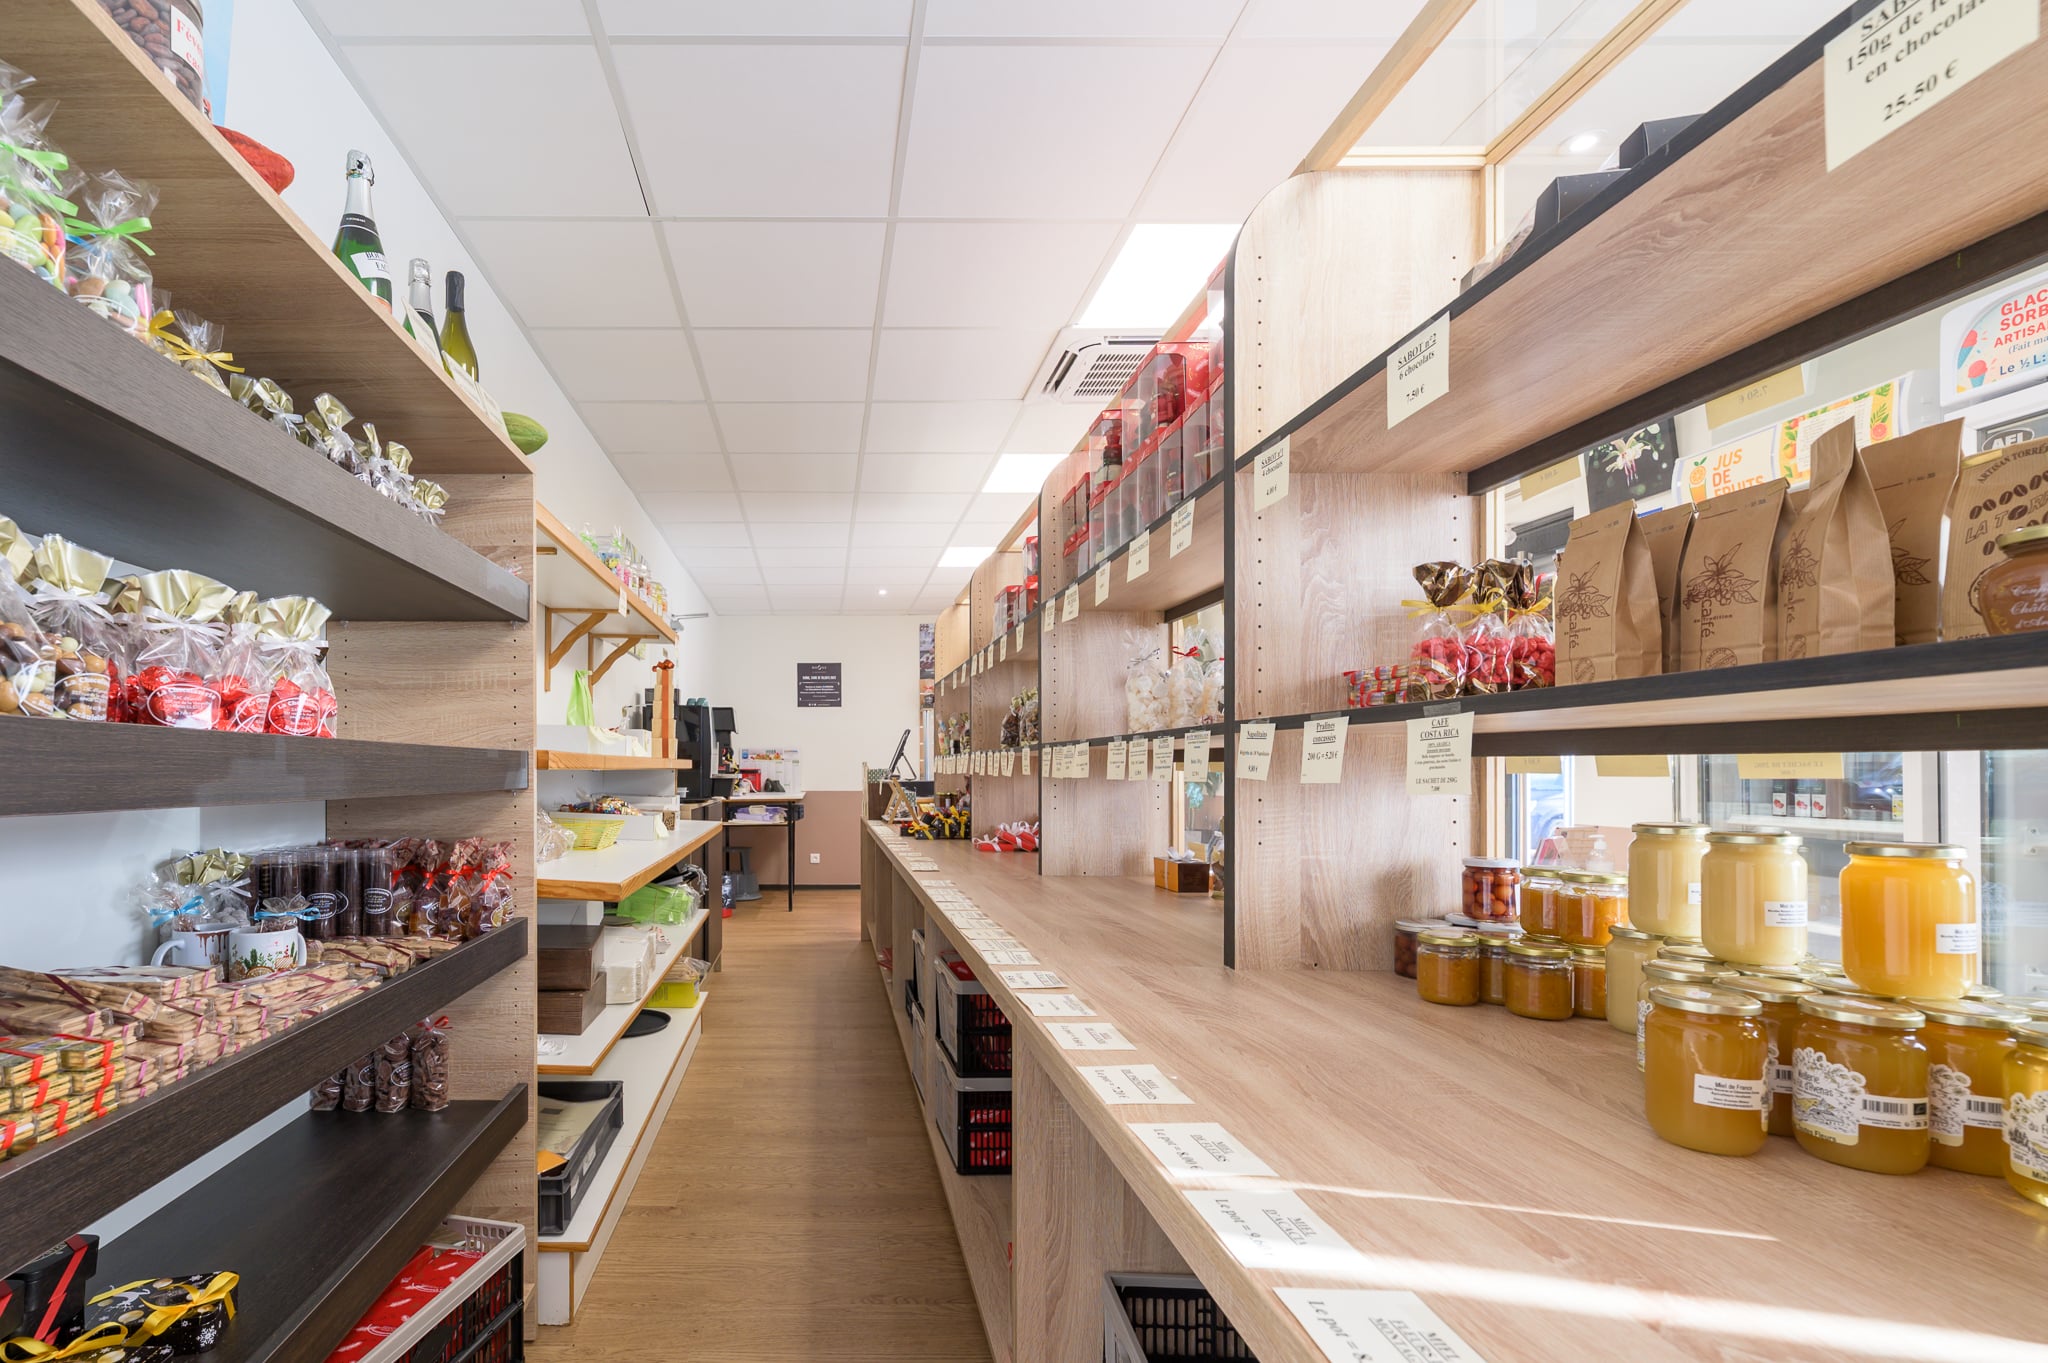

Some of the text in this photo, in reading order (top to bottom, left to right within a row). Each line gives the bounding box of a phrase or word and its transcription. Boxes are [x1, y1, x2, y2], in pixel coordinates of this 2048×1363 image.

[1848, 10, 1925, 72] 150g de
[1865, 63, 1888, 84] en
[1883, 58, 1960, 122] 25.50 €
[1994, 319, 2048, 348] ARTISA
[1398, 342, 1424, 367] SABOT
[1404, 351, 1435, 377] chocolats
[2000, 364, 2015, 376] Le
[1713, 448, 1743, 471] JUS
[1712, 468, 1731, 487] DE
[1965, 520, 1988, 544] LA
[1702, 599, 1715, 638] café
[1570, 613, 1579, 649] café
[1420, 728, 1459, 739] COSTA RICA
[1154, 1128, 1166, 1136] Le
[1158, 1136, 1177, 1146] pot
[1201, 1142, 1230, 1162] FLEURS
[1215, 1199, 1230, 1209] Le
[1221, 1209, 1245, 1223] pot
[1294, 1217, 1317, 1235] MIEL
[1266, 1209, 1308, 1246] D'ACACIA
[1308, 1300, 1329, 1316] Le
[1317, 1317, 1350, 1338] pot
[1391, 1319, 1434, 1360] FLEURS
[1427, 1332, 1461, 1359] MIEL
